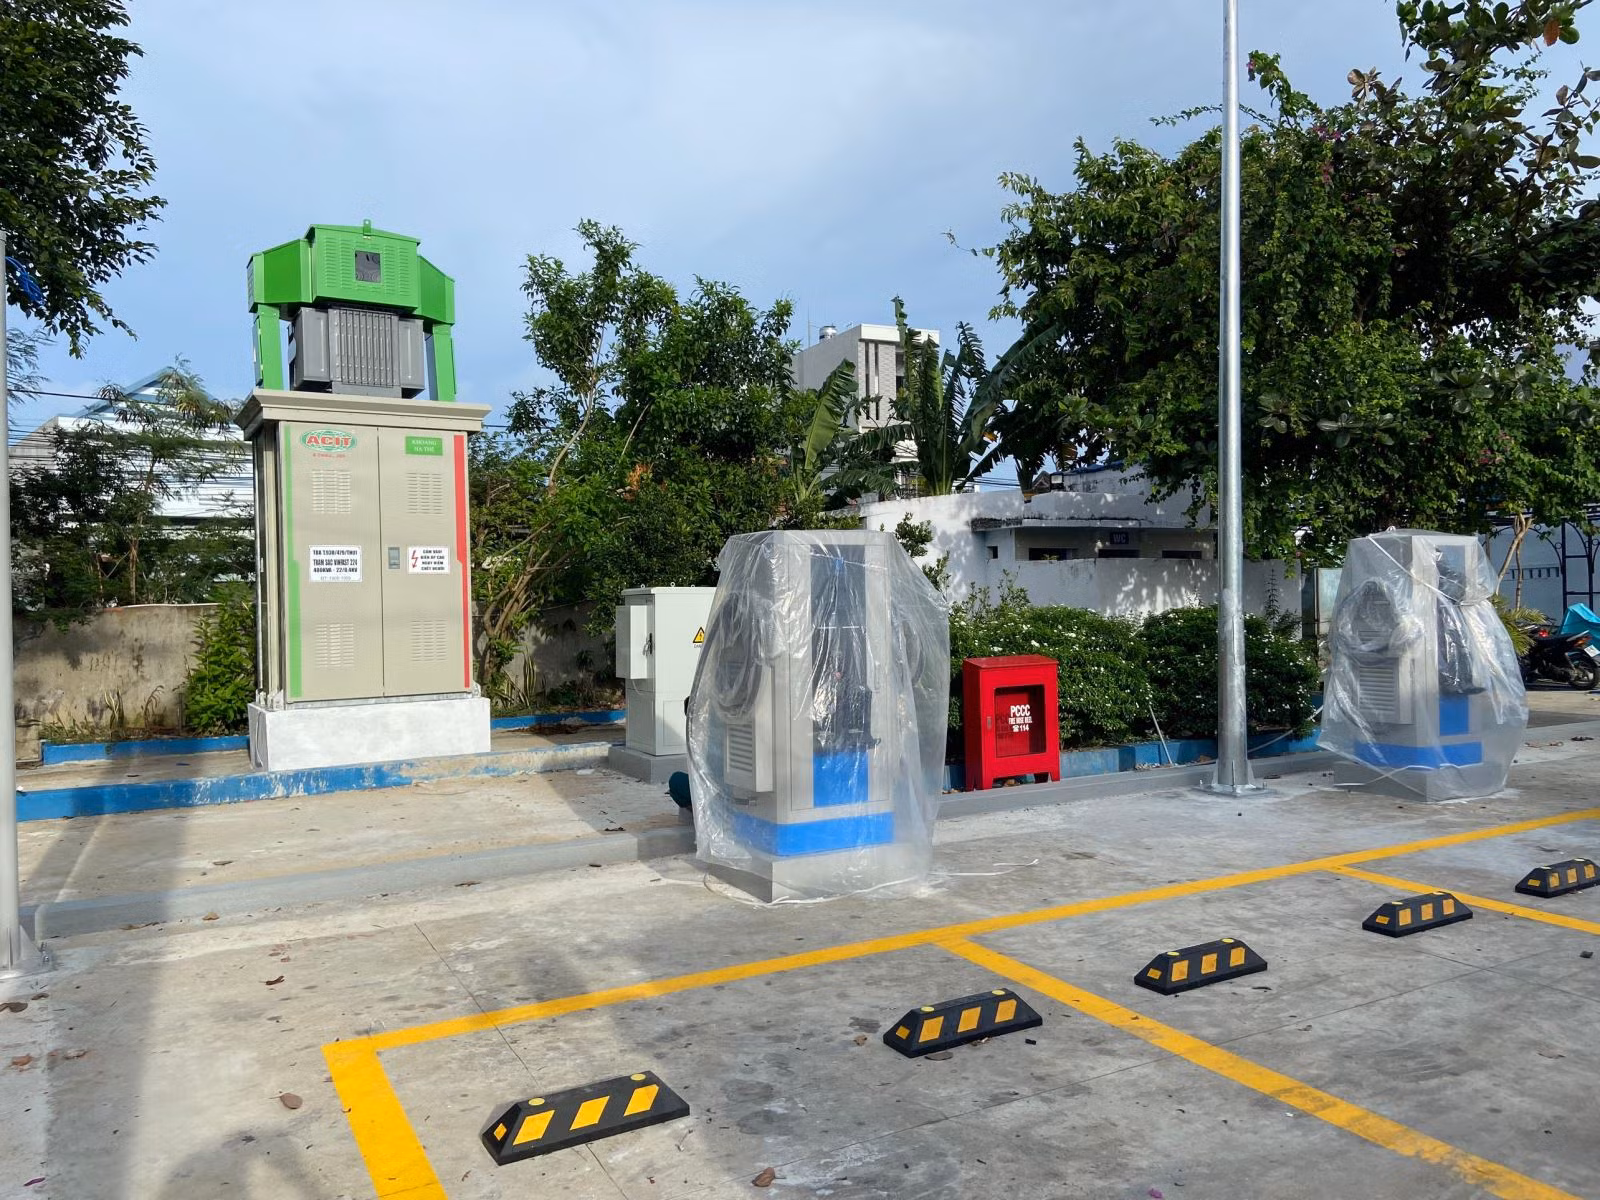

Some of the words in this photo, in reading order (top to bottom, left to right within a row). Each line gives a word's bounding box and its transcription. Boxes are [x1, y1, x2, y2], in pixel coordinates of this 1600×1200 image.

[306, 435, 352, 446] ACIT
[1113, 533, 1126, 543] WC
[1010, 704, 1030, 717] PCCC
[1020, 724, 1029, 732] 114
